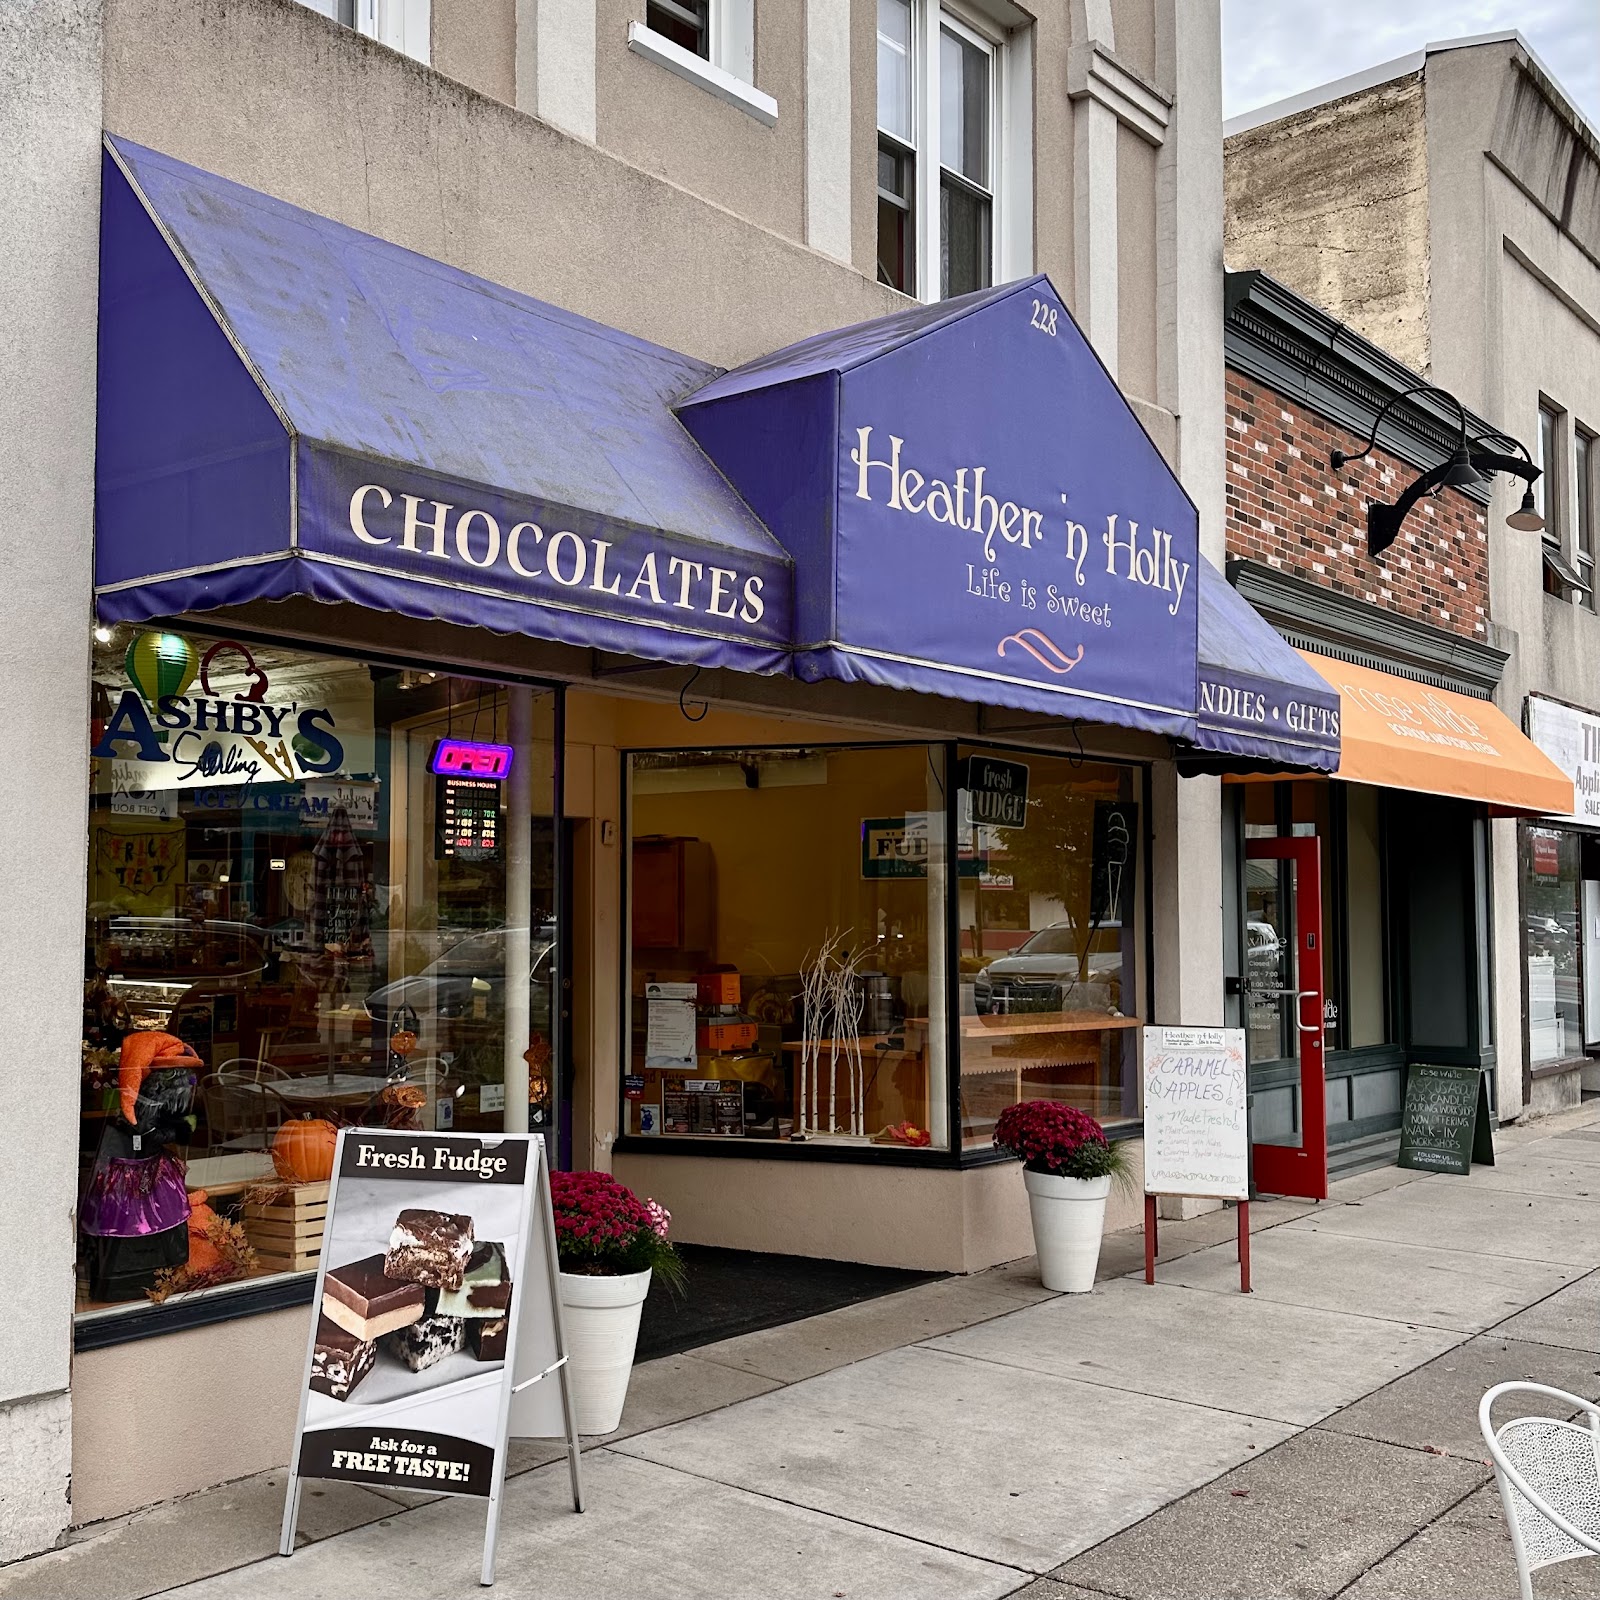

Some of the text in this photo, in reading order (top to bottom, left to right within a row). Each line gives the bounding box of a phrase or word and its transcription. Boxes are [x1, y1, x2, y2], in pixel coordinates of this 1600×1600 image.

[1030, 299, 1058, 337] 228
[850, 426, 1044, 562] Heather
[1102, 514, 1190, 616] Holly
[349, 484, 765, 624] CHOCOLATES
[966, 563, 1113, 628] Life is Sweet
[1200, 681, 1340, 737] NDIES GIFTS
[1338, 683, 1423, 725] rose
[90, 690, 344, 774] ASHBY'S
[437, 746, 508, 773] OPEN
[447, 780, 476, 788] BUSINESS
[983, 763, 1012, 791] fresh
[193, 789, 330, 814] ICE CREAM
[969, 789, 1024, 823] FUDGE
[1161, 1056, 1231, 1079] CARAMEL
[1407, 1093, 1470, 1106] OUR CANDLE
[1409, 1080, 1478, 1097] ASK US ABOUT
[1167, 1108, 1200, 1125] Made
[1405, 1102, 1439, 1113] POURING
[1411, 1115, 1470, 1127] NOW OFFERING
[1404, 1125, 1435, 1137] WALK
[1443, 1126, 1458, 1138] IN
[356, 1144, 508, 1178] Fresh Fudge
[1417, 1151, 1441, 1159] FOLLOW
[370, 1436, 438, 1456] Ask for a
[331, 1450, 471, 1482] FREE TASTE!
